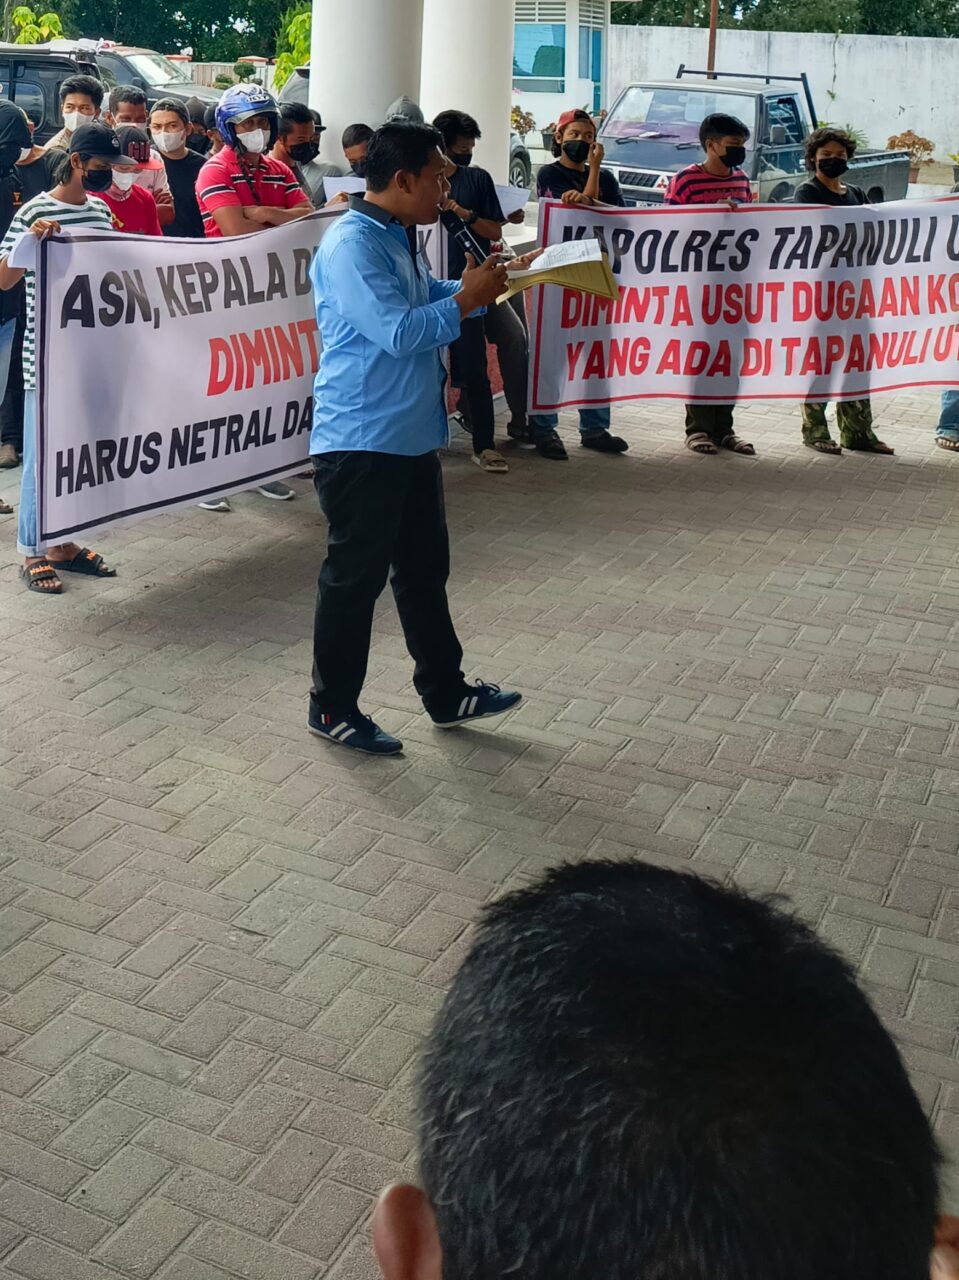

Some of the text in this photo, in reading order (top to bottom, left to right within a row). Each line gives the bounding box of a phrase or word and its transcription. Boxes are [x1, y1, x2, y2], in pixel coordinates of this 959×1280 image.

[769, 216, 937, 270] TAPANULI
[60, 269, 160, 329] ASN,
[156, 252, 287, 318] KEPALA
[293, 247, 318, 296] D
[701, 282, 784, 324] USUT
[792, 275, 920, 324] DUGAAN
[207, 318, 319, 396] DIMINT
[566, 337, 649, 381] YANG
[656, 339, 731, 377] ADA
[741, 338, 772, 377] DI
[781, 328, 932, 376] TAPANULI
[56, 396, 313, 497] HARUS NETRAL DA
